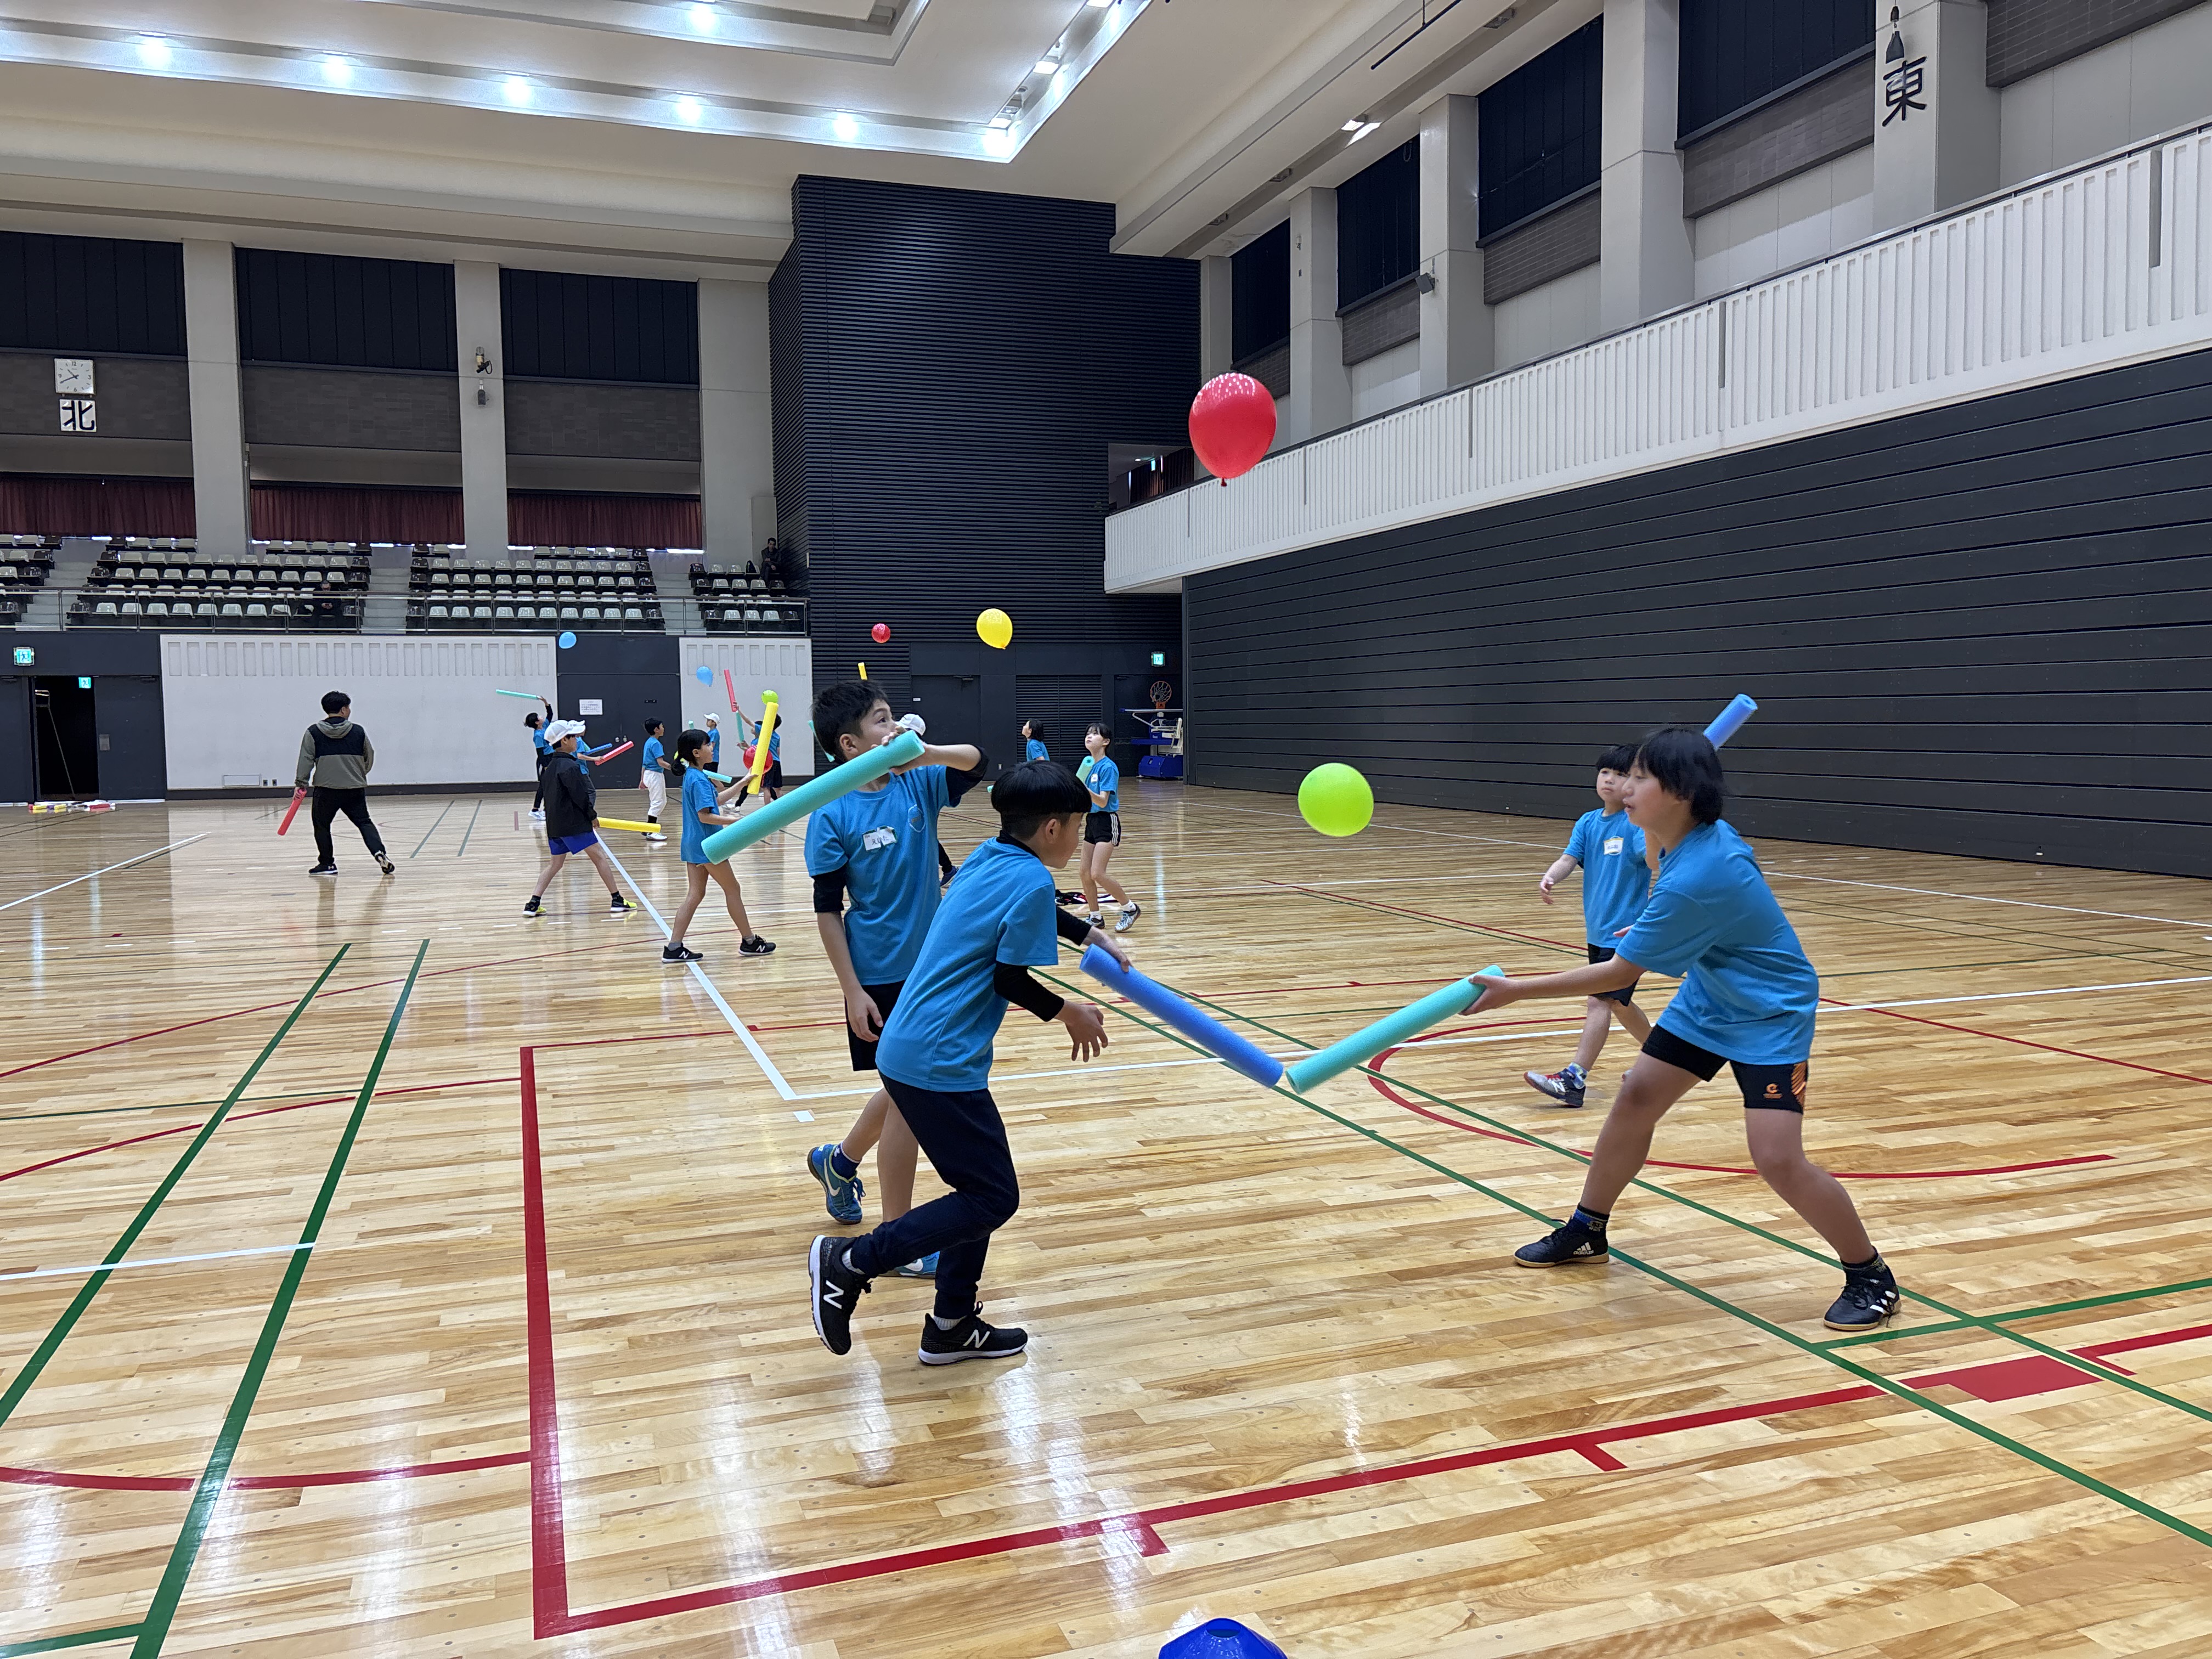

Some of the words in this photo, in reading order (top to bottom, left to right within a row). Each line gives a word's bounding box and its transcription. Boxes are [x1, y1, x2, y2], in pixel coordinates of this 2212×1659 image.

[1882, 56, 1927, 127] 東
[61, 400, 94, 431] 北
[679, 951, 690, 959] N
[755, 945, 766, 953] N
[823, 1279, 844, 1310] N
[963, 1329, 991, 1348] N
